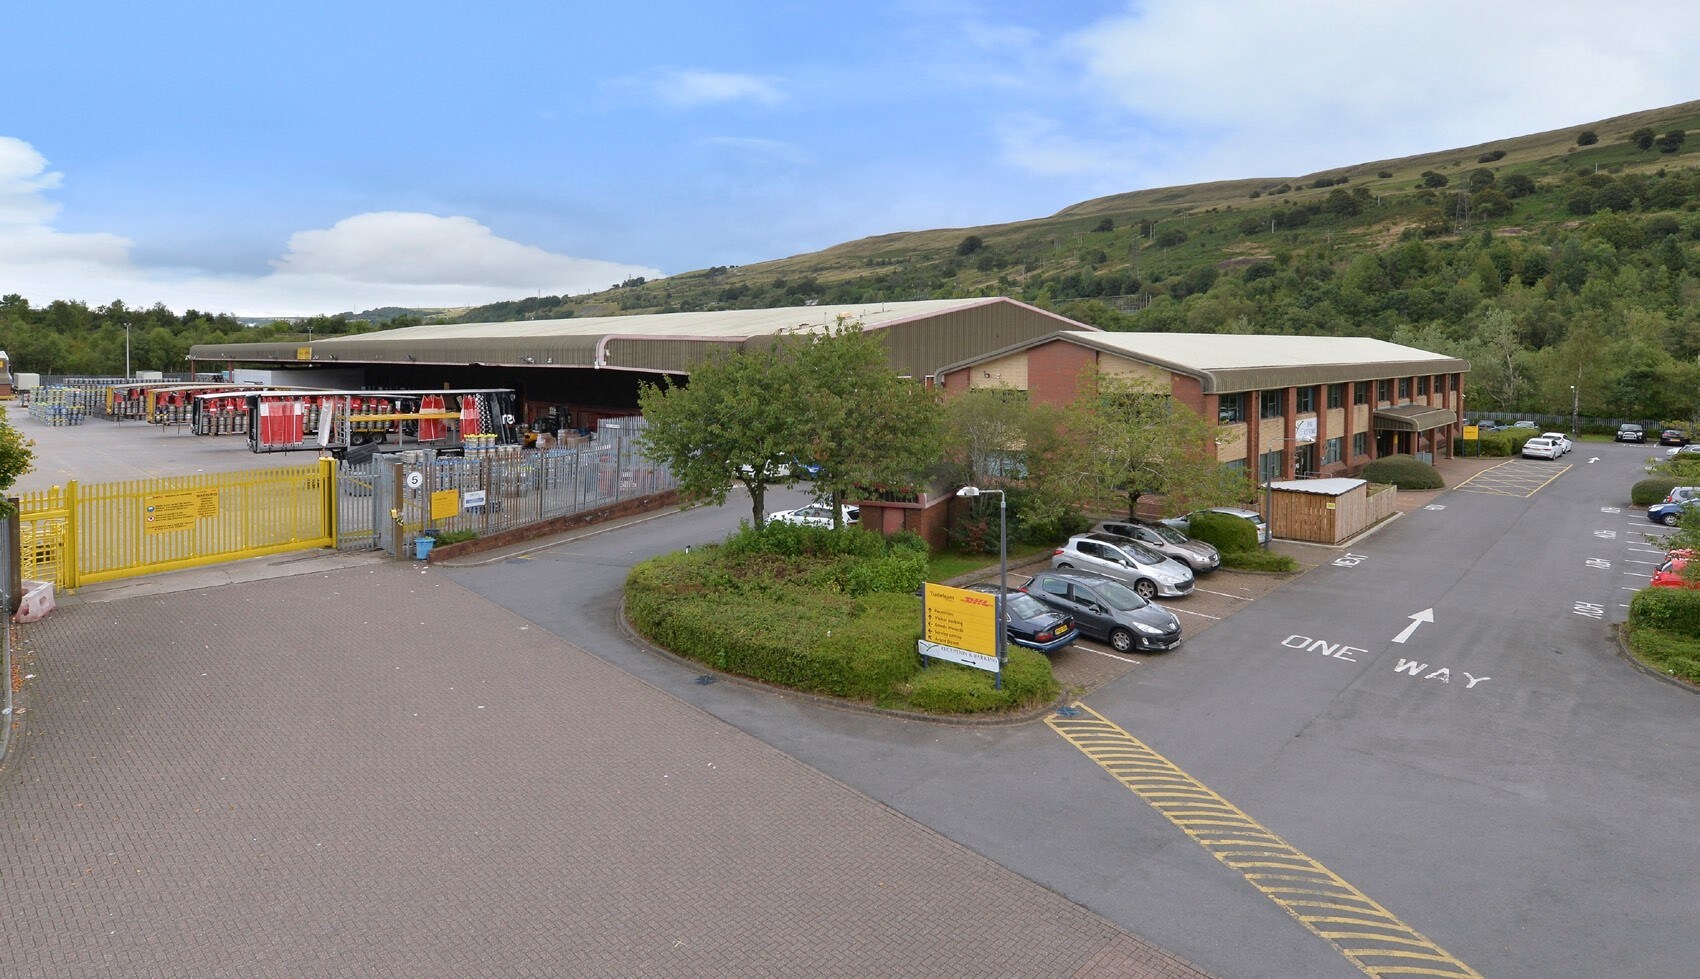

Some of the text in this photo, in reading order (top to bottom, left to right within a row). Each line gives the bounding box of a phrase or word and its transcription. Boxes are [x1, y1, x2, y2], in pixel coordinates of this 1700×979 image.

[411, 475, 418, 485] 5
[965, 596, 990, 607] DHL
[934, 608, 954, 616] Reception
[948, 619, 964, 627] parking
[940, 646, 968, 656] RECEPTION
[973, 654, 998, 663] PARKING
[1281, 634, 1491, 689] ONE WAY
